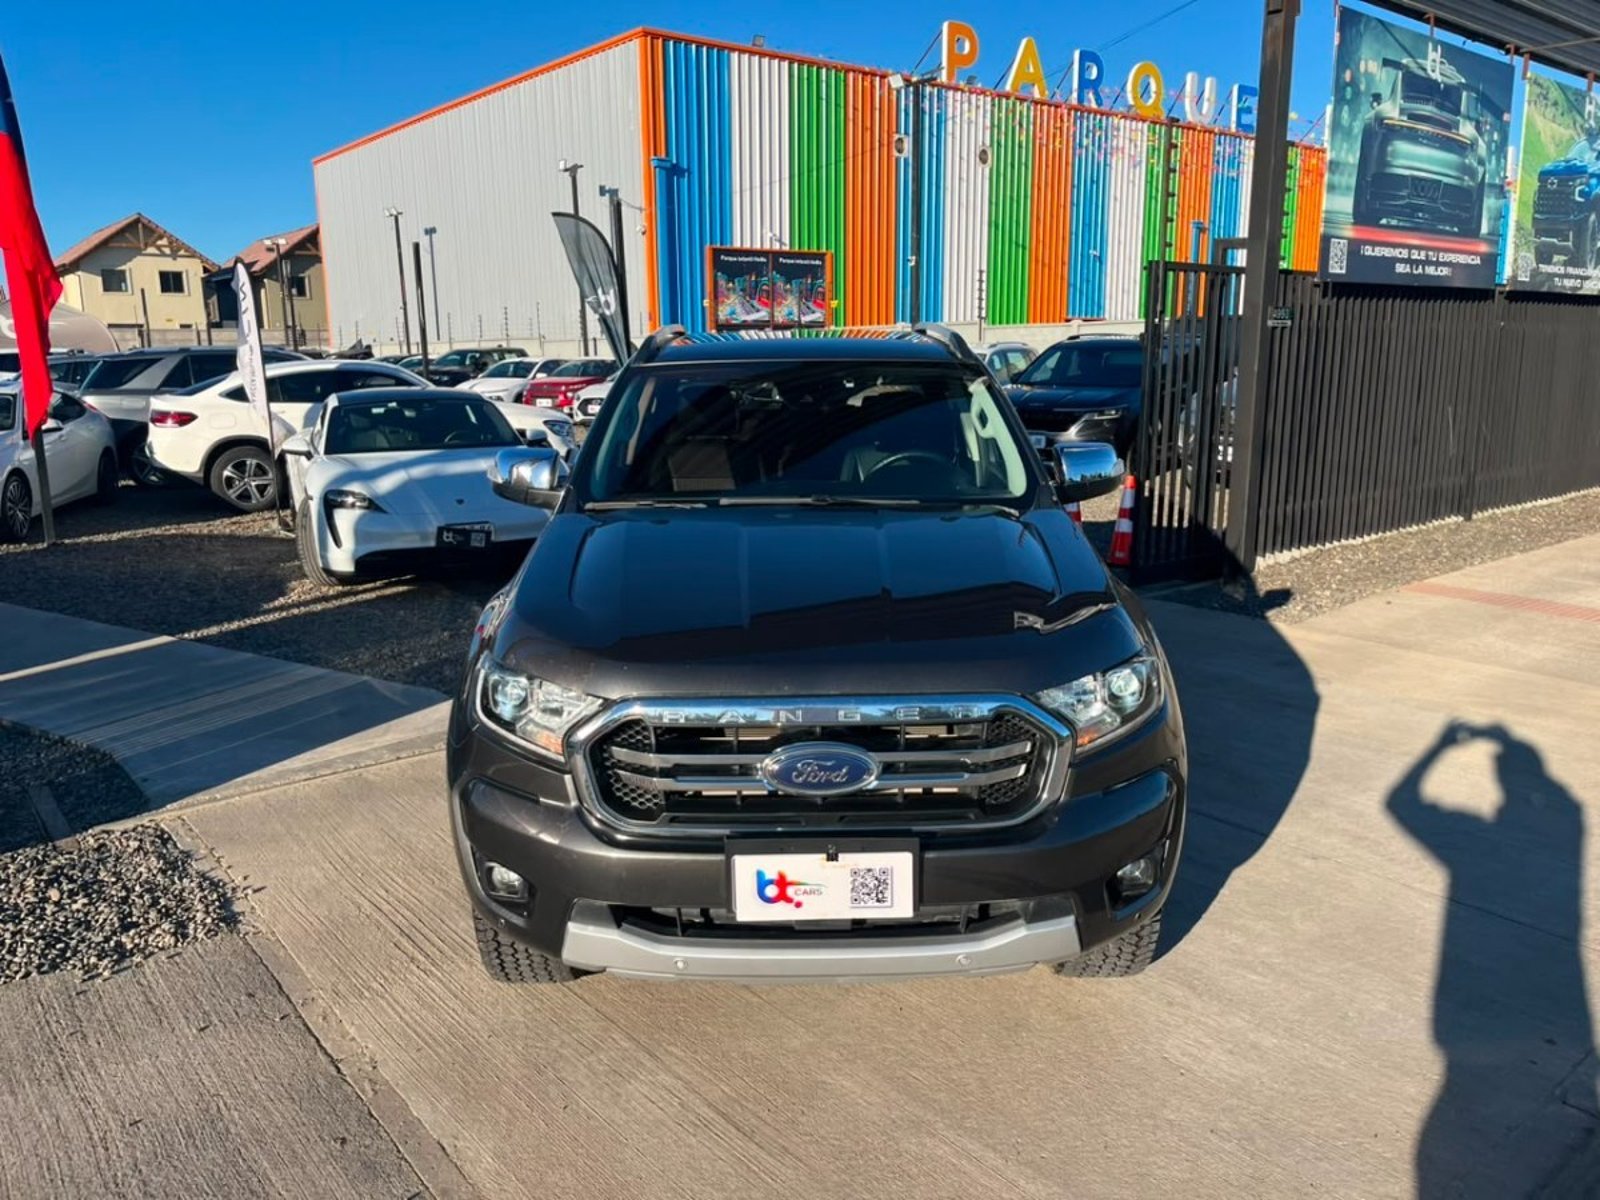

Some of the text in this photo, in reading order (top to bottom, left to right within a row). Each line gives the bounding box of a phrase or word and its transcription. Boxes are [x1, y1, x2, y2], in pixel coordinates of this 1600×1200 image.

[942, 20, 1258, 132] PARQUE
[1411, 249, 1426, 260] QUE
[1428, 251, 1437, 260] TU
[1395, 263, 1411, 273] SEA
[1413, 264, 1423, 274] LA
[662, 704, 984, 724] RANGER
[792, 759, 850, 783] Ford
[794, 888, 823, 897] CARS
